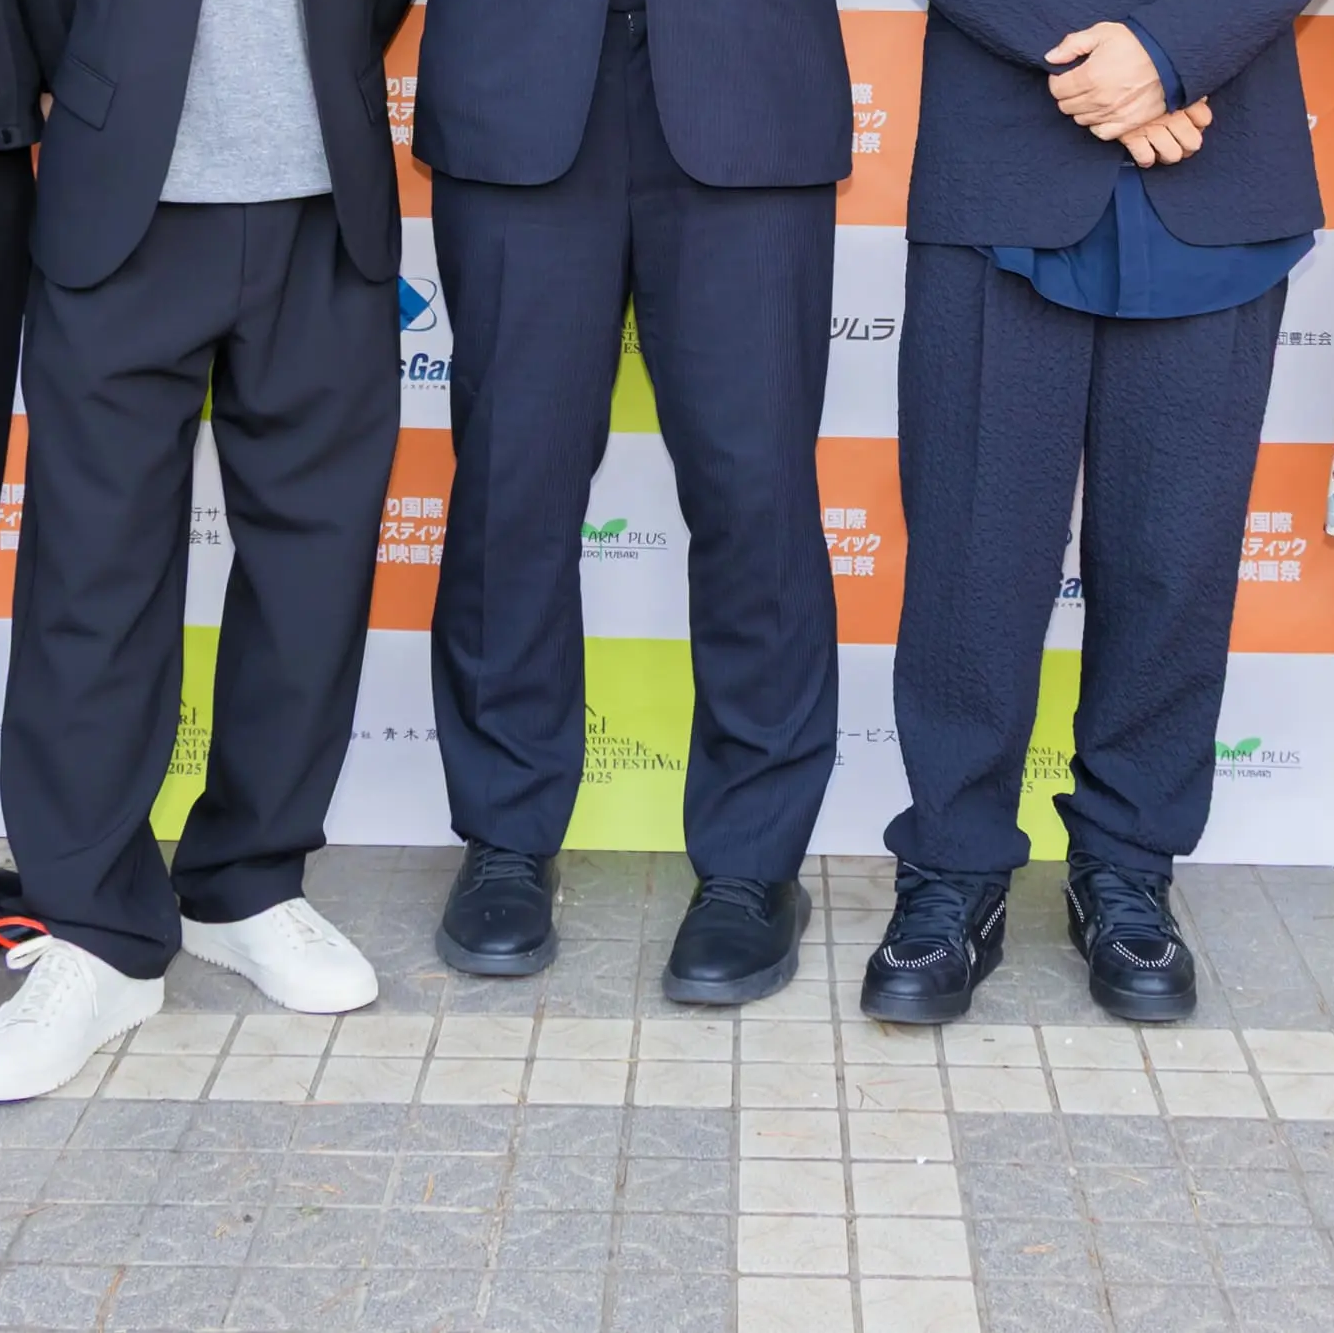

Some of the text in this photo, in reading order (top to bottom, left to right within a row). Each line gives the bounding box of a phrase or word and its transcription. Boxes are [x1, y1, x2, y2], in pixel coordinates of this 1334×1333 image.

[627, 531, 667, 545] PLUS
[613, 753, 686, 771] FESTIVAL
[1261, 750, 1302, 764] PLUS
[167, 762, 202, 776] 2025
